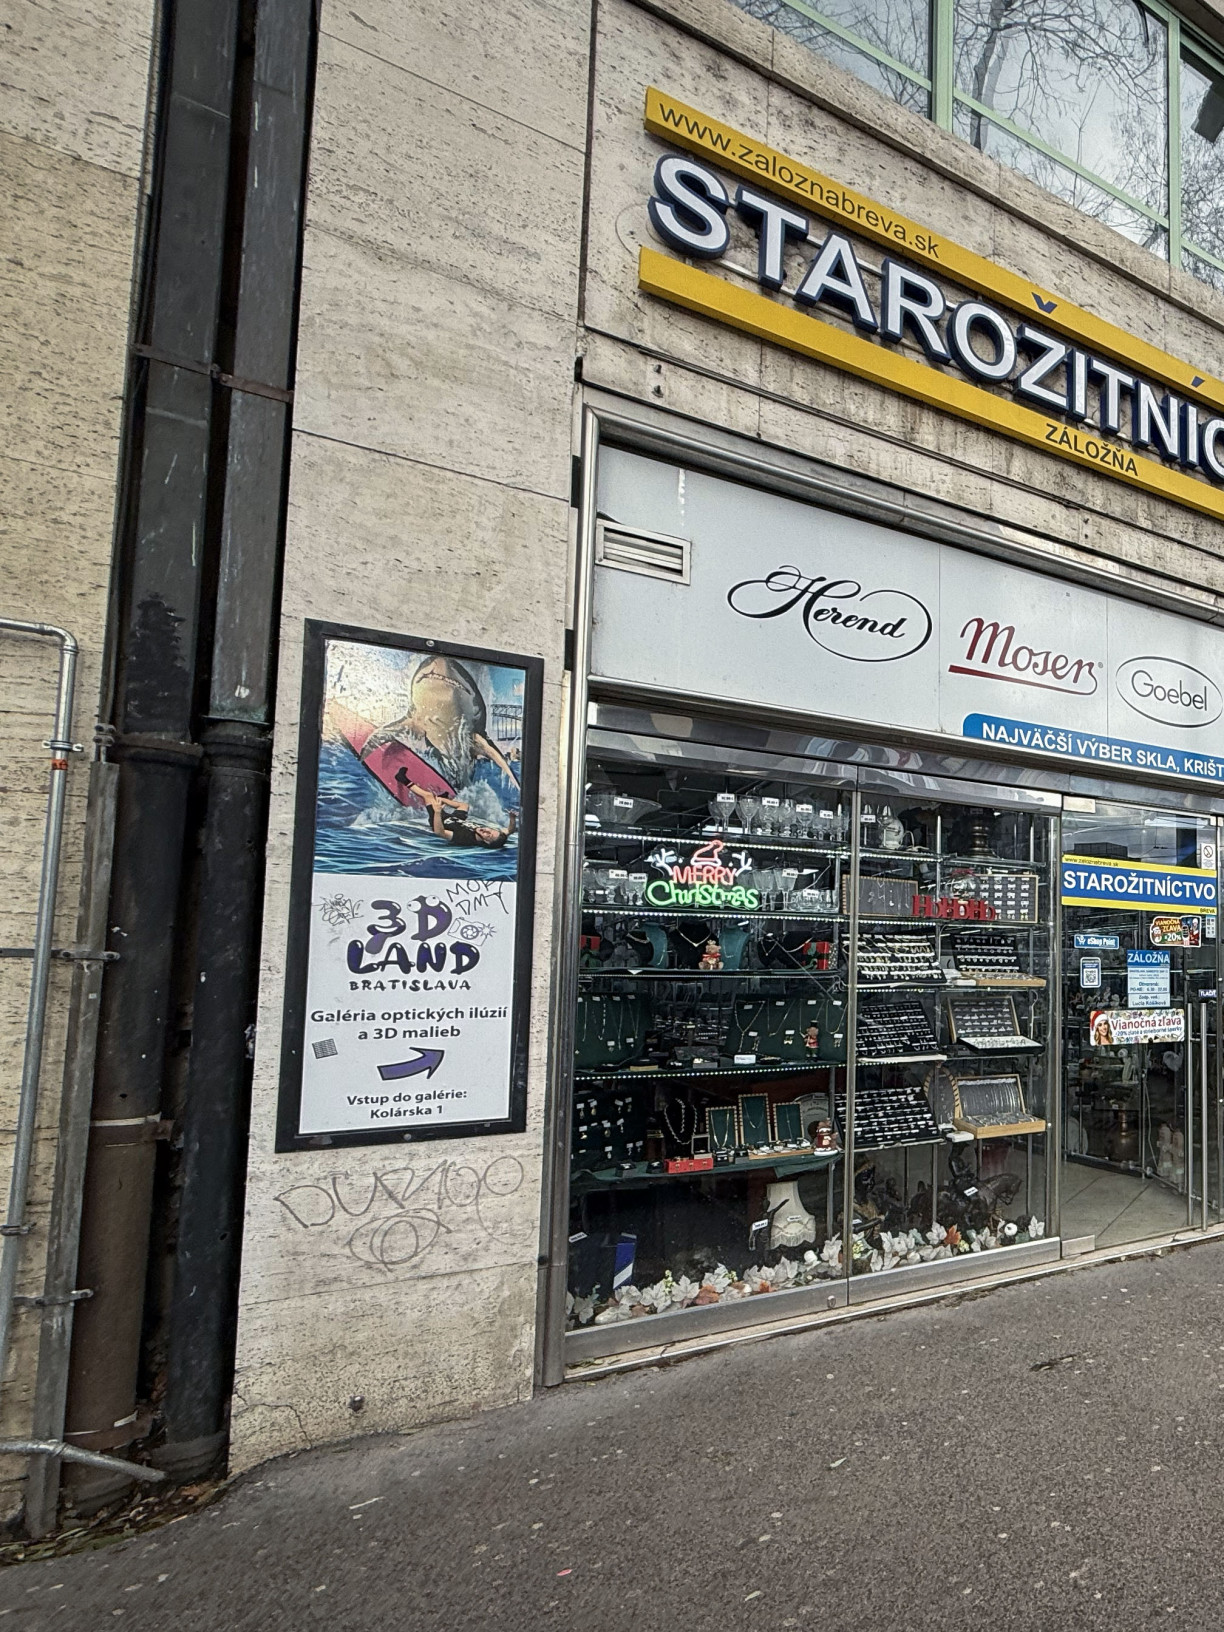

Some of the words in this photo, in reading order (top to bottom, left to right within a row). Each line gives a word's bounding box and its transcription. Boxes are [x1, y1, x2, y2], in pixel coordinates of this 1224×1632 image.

[659, 104, 939, 260] www.zaloznabreva.sk
[1045, 422, 1138, 478] ZÁLOŽŇA
[727, 564, 932, 663] Herend
[960, 617, 1097, 686] Moser
[1131, 669, 1208, 712] Goebel
[982, 721, 1073, 754] NAJVÄČŠÍ
[1077, 739, 1132, 764] VÝBER
[1136, 748, 1181, 774] SKLA,
[672, 865, 736, 886] MERRY
[1064, 870, 1215, 900] STAROŽITNÍCTVO
[648, 880, 759, 910] Christmas
[367, 895, 453, 944] 3D
[347, 940, 480, 975] LAND
[1128, 951, 1170, 963] ZÁLOŽŇA
[349, 979, 472, 992] BRATISLAVA
[311, 1009, 376, 1022] Galéria
[381, 1007, 464, 1022] optických
[469, 1006, 508, 1019] ilúzií
[1111, 1016, 1156, 1030] Vianočná
[1158, 1016, 1182, 1027] zľava
[358, 1030, 368, 1040] a
[374, 1028, 398, 1040] 3D
[402, 1026, 461, 1039] malieb
[347, 1095, 389, 1106] Vstup
[393, 1092, 411, 1102] do
[415, 1090, 467, 1103] galérie:
[370, 1107, 432, 1119] Kolárska
[437, 1105, 443, 1114] 1
